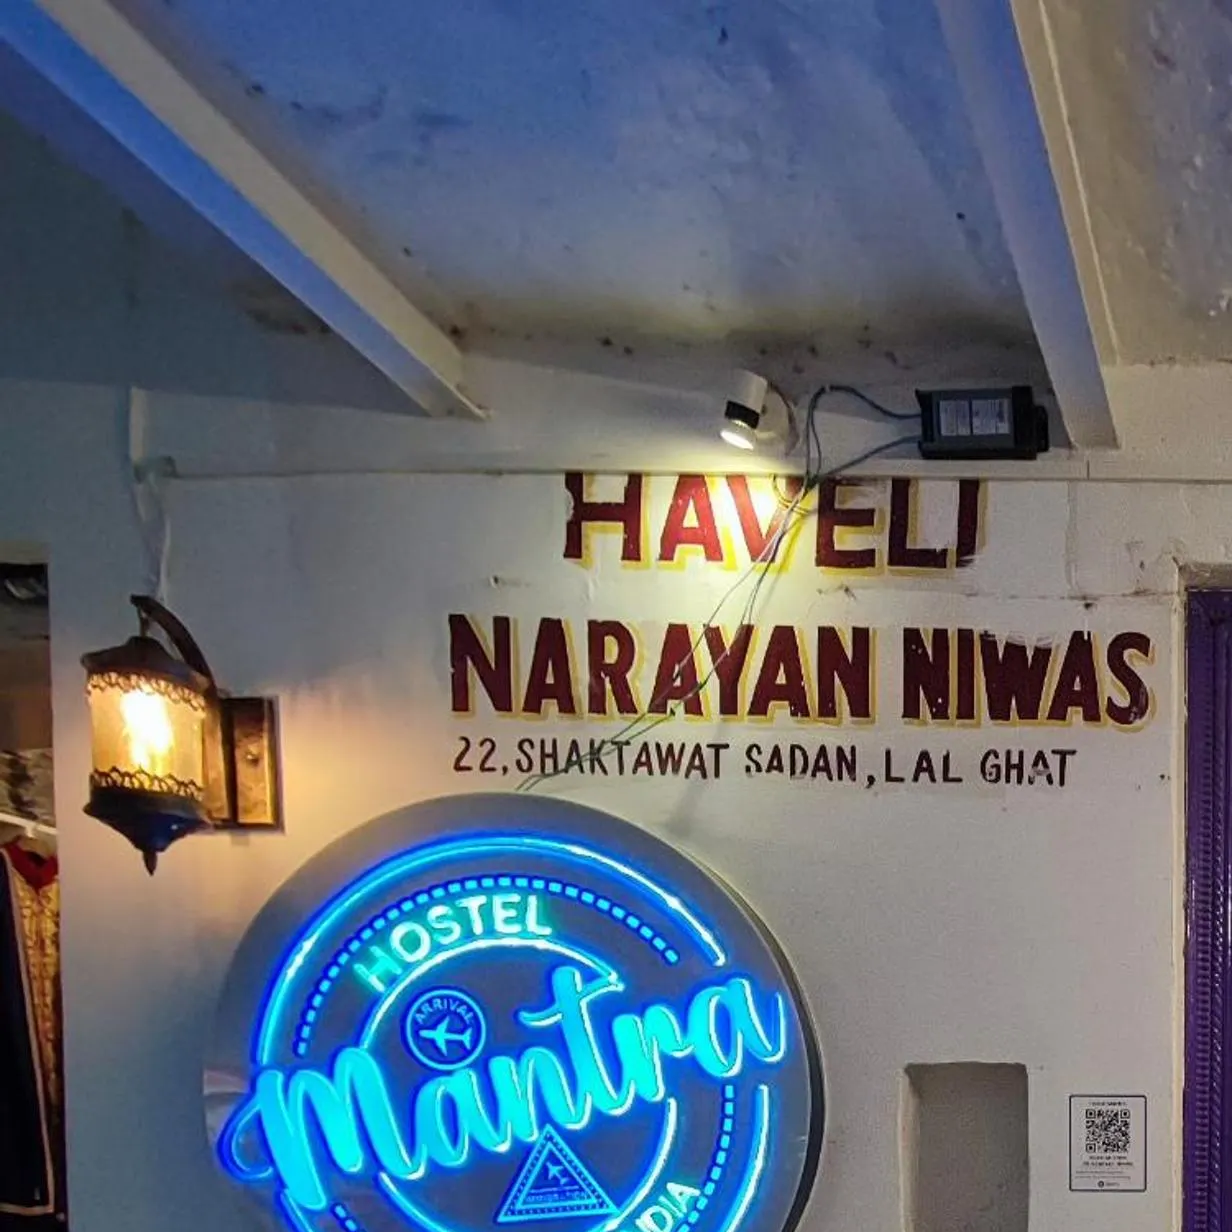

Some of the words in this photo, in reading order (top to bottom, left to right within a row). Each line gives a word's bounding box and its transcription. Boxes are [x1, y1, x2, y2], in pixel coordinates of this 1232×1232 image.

[563, 473, 984, 570] HAVELI
[448, 612, 876, 722] NARAYAN
[901, 627, 1155, 730] NIWAS
[980, 749, 1076, 787] GHAT
[354, 893, 553, 993] HOSTEL
[415, 998, 474, 1026] ARRIVAL
[224, 966, 787, 1212] Mantra
